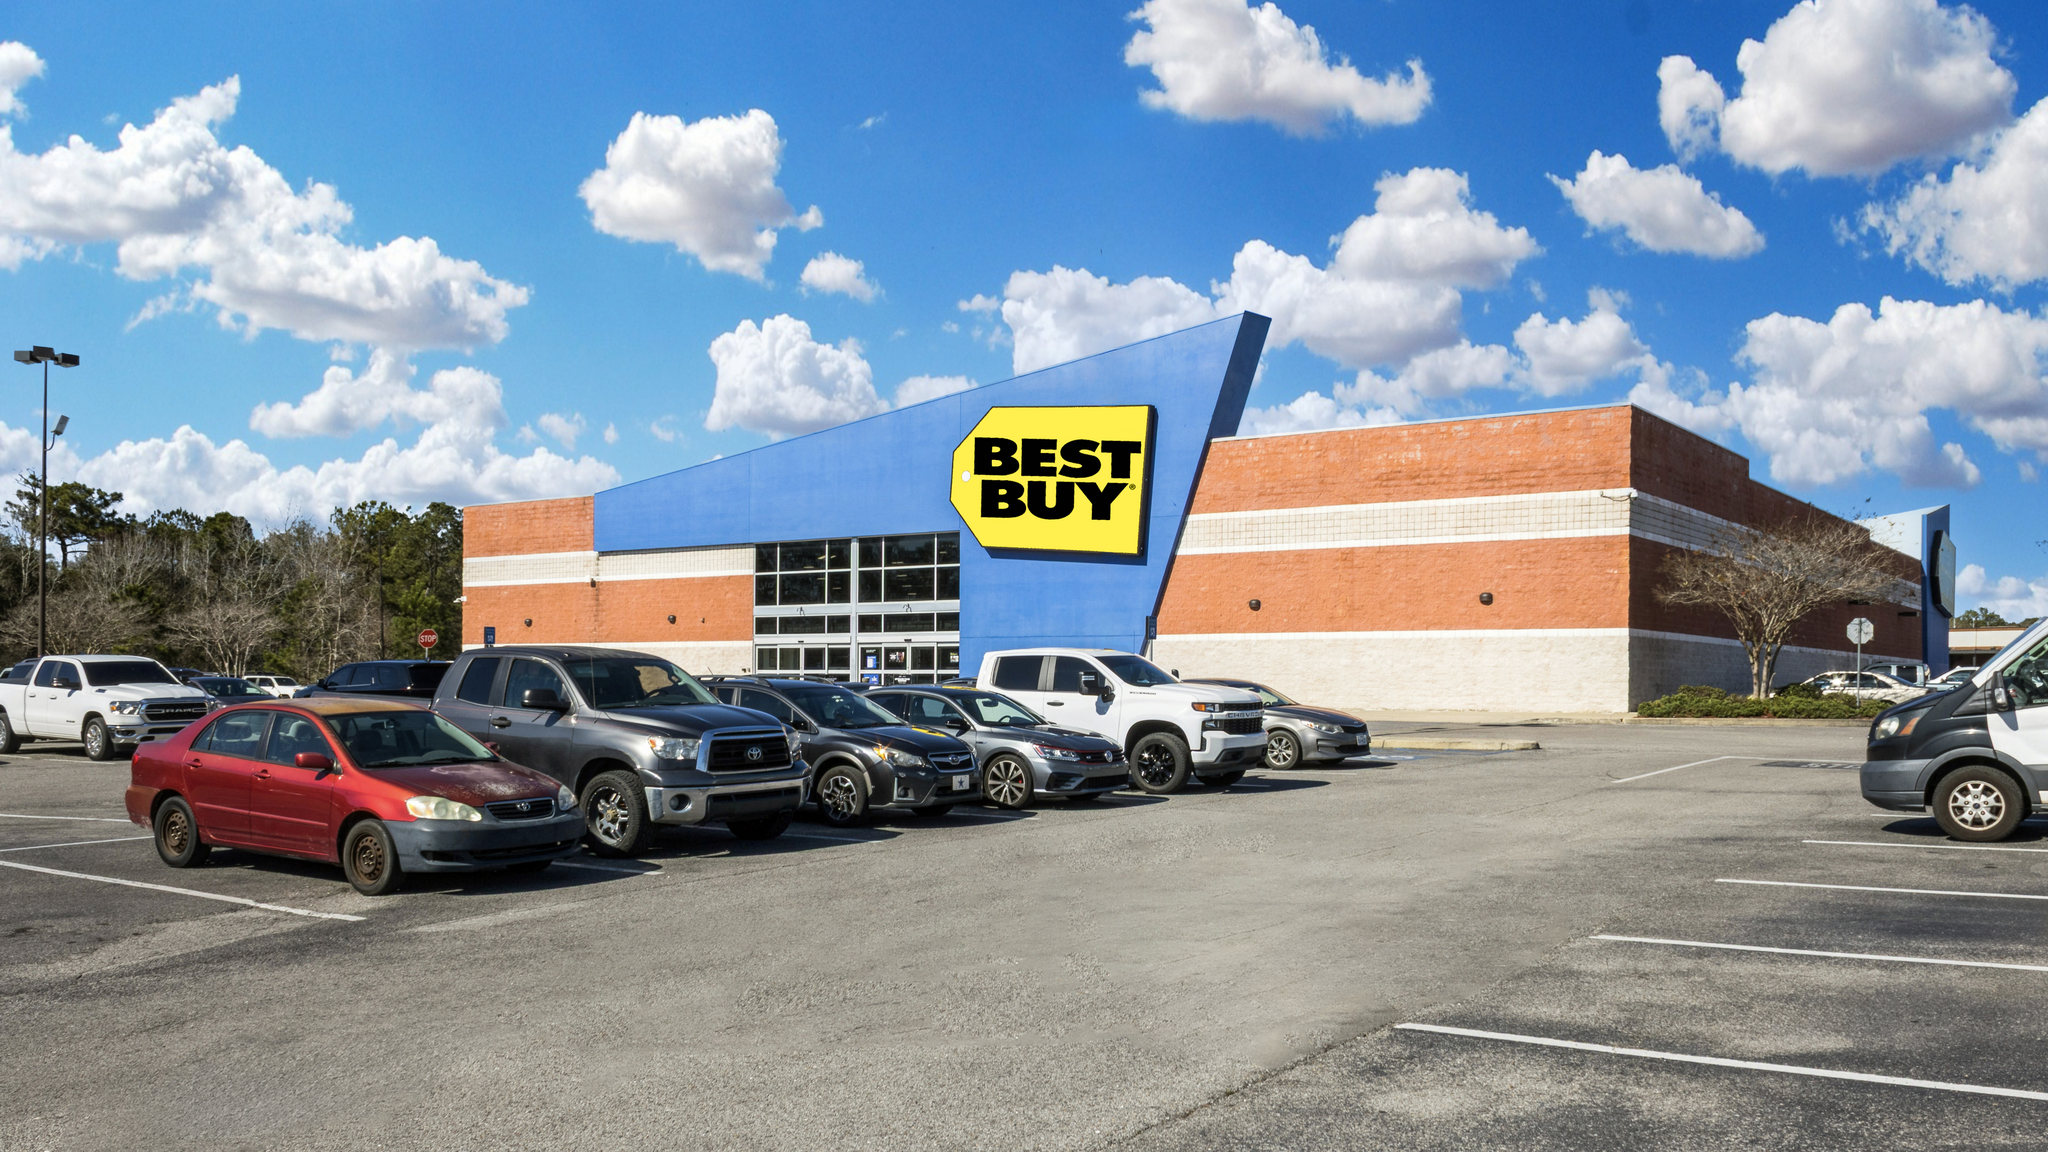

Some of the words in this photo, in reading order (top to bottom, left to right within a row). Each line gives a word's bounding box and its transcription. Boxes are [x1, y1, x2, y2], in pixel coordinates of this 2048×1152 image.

[974, 437, 1142, 479] BEST
[980, 479, 1129, 520] BUY
[420, 634, 437, 643] STOP
